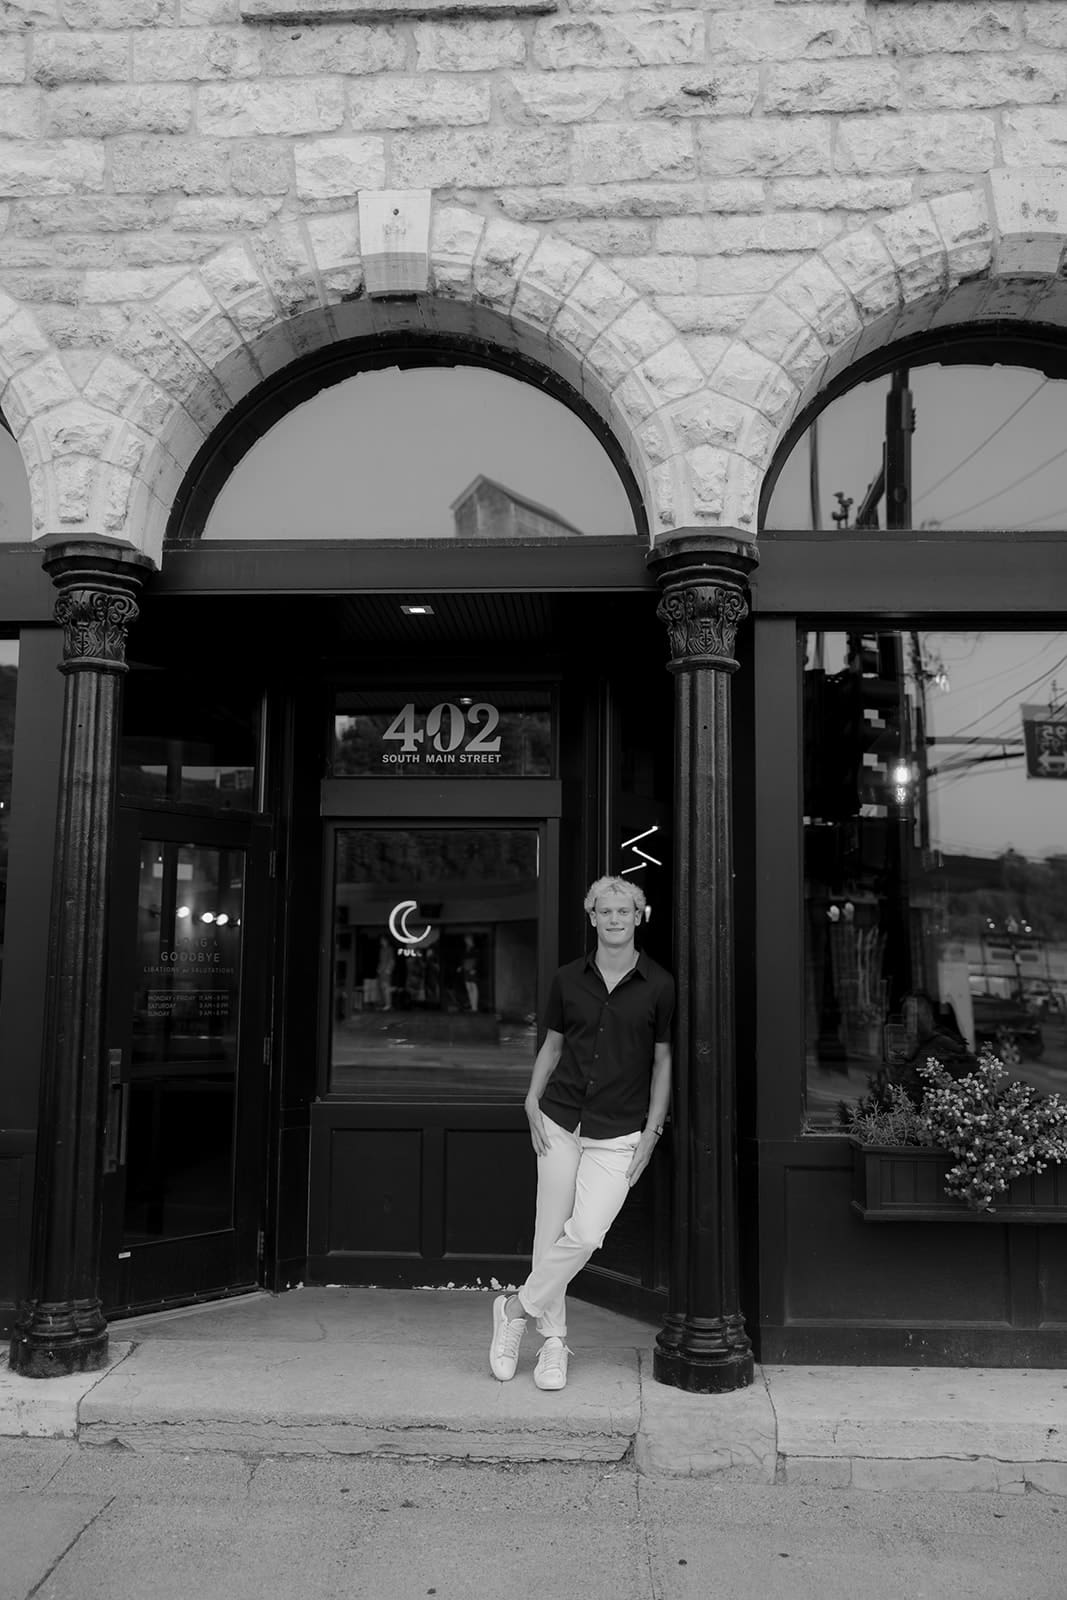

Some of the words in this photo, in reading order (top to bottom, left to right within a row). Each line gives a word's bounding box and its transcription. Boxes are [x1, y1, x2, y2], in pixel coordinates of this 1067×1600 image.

[382, 702, 502, 752] 402
[382, 754, 420, 763] SOUTH
[426, 754, 455, 763] MAIN
[459, 754, 502, 763] STREET
[160, 951, 221, 963] GOODBYE
